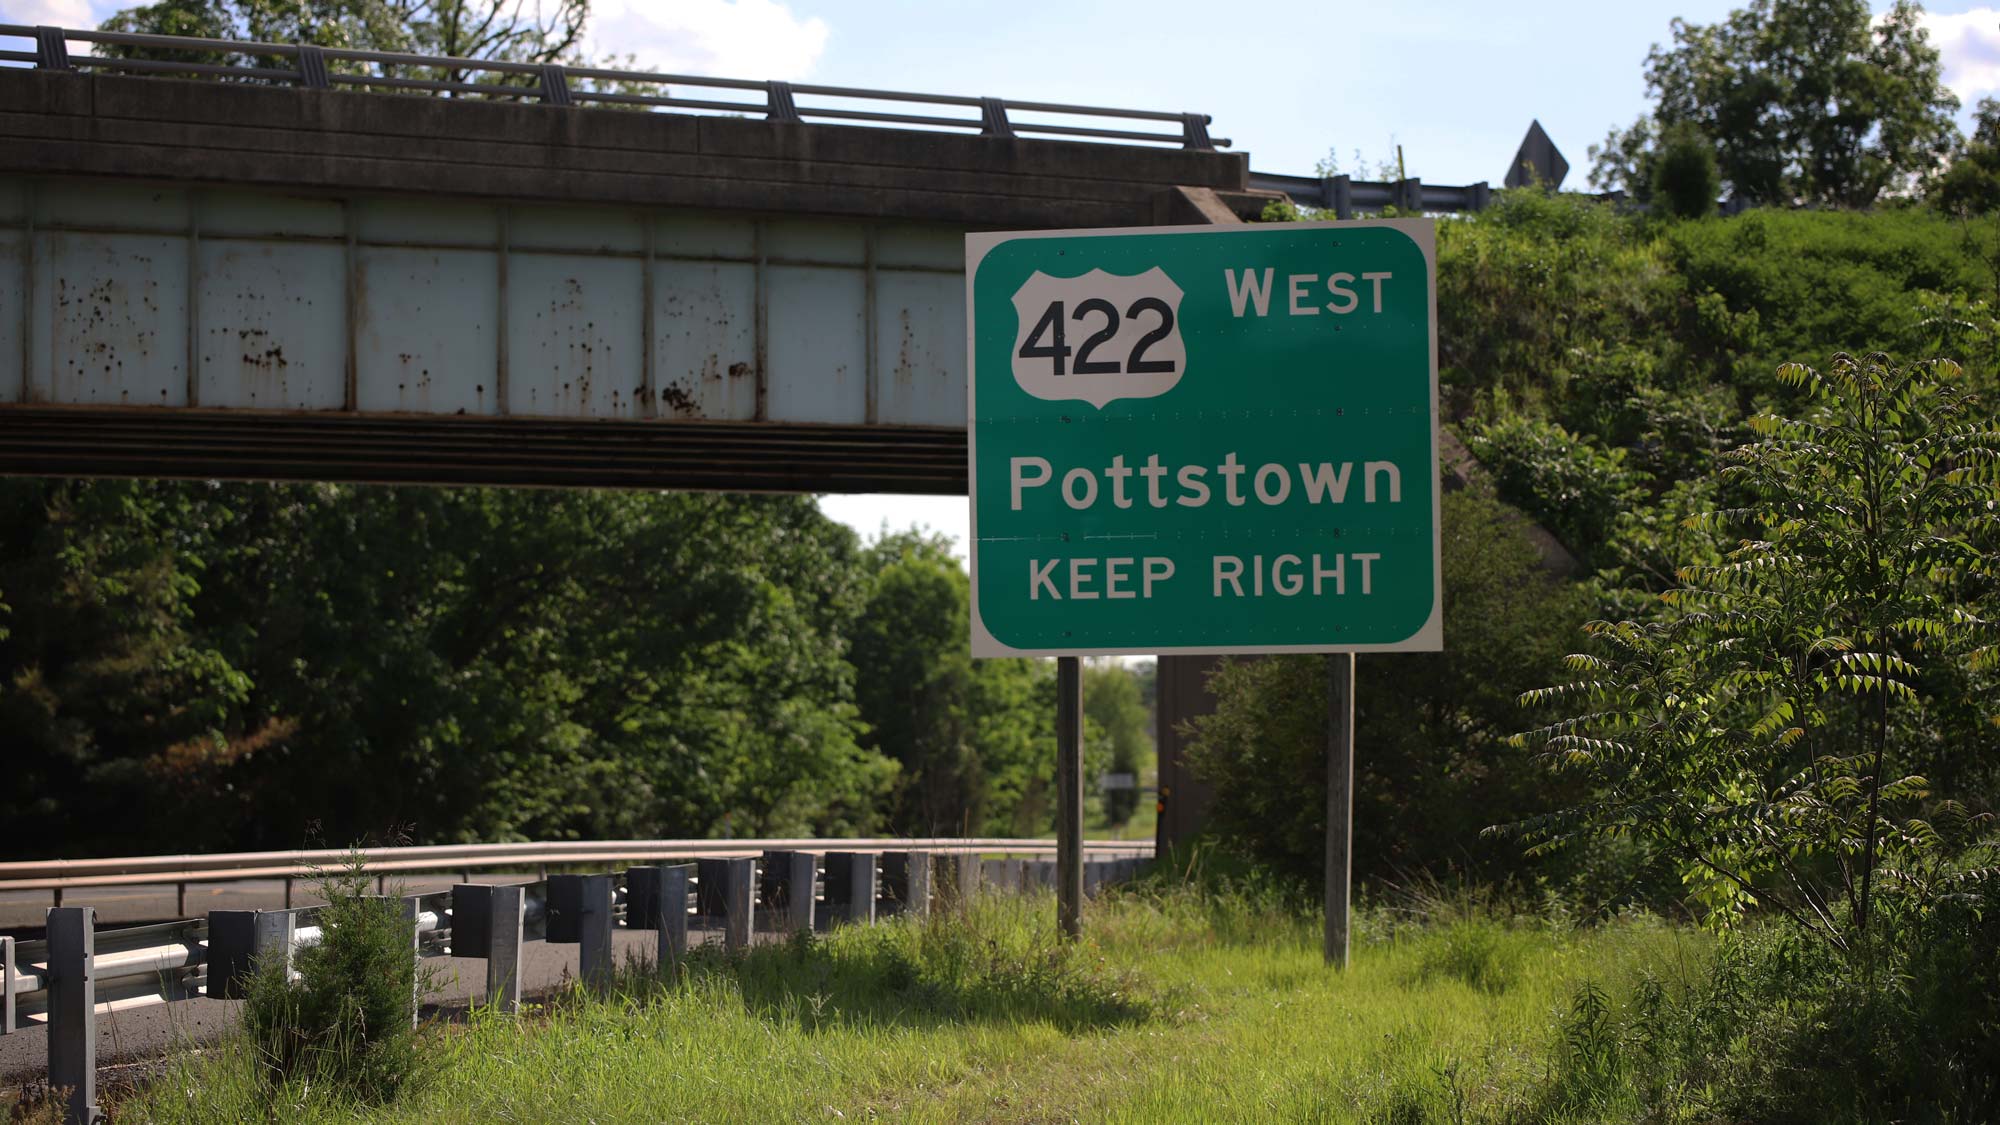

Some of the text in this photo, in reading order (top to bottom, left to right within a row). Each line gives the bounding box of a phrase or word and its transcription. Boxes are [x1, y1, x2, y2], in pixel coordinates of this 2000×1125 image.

[1225, 268, 1393, 318] WEST
[1018, 296, 1176, 376] 422
[1010, 452, 1402, 511] Pottstown
[1030, 553, 1381, 601] KEEP RIGHT
